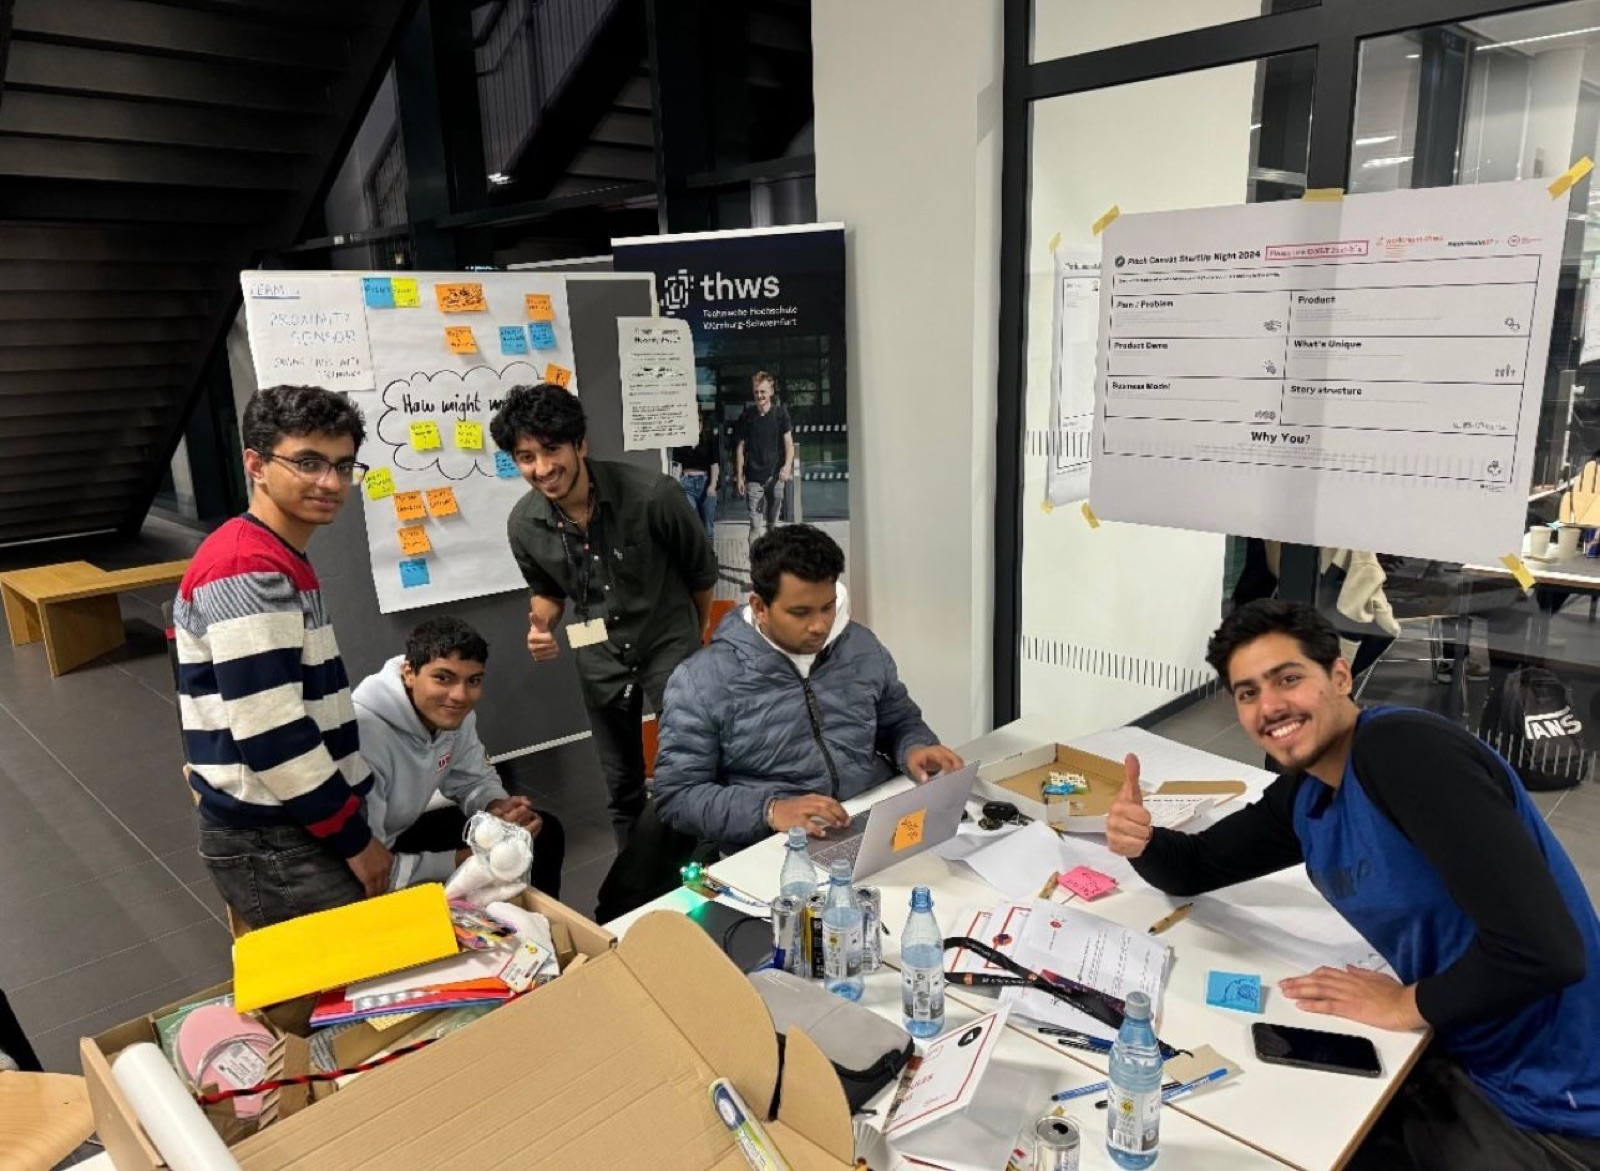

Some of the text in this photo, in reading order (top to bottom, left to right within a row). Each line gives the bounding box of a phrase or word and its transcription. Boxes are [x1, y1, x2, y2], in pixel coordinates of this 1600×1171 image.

[1214, 251, 1236, 262] Night
[1238, 250, 1261, 259] 2024
[700, 271, 780, 300] thws
[1141, 299, 1174, 308] Problem
[1298, 295, 1336, 304] Product
[703, 305, 798, 318] Technische Hochschule
[1114, 341, 1144, 350] Product
[1294, 339, 1362, 349] What's Unique
[1146, 382, 1171, 390] Model
[1290, 385, 1362, 395] Story structure
[402, 393, 435, 415] How
[442, 391, 481, 422] might
[1251, 431, 1311, 444] Why You?
[1524, 705, 1582, 739] VANS
